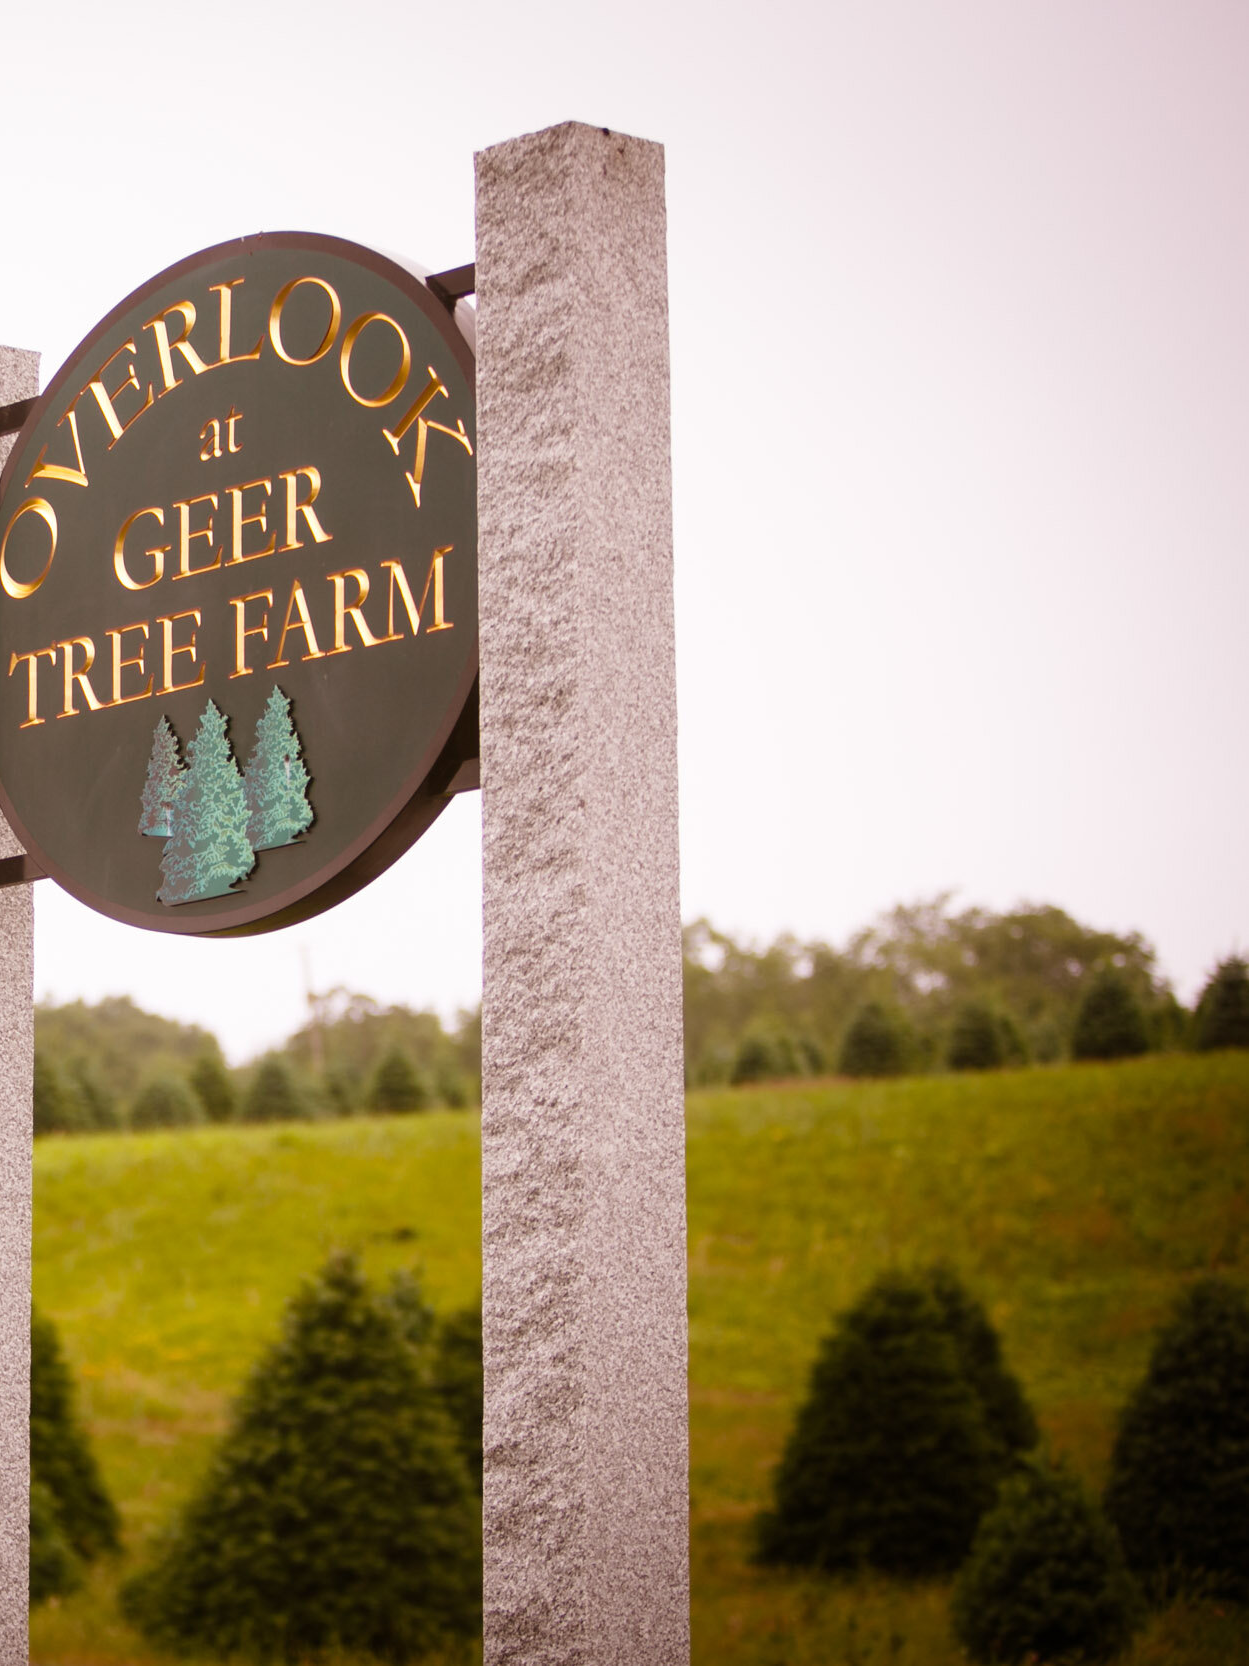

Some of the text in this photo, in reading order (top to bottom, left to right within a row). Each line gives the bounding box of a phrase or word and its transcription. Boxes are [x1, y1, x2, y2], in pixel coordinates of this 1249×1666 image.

[0, 277, 473, 599] OVERLOOK
[199, 404, 243, 461] at
[113, 466, 333, 590] GEER
[8, 545, 454, 729] TREE FARM
